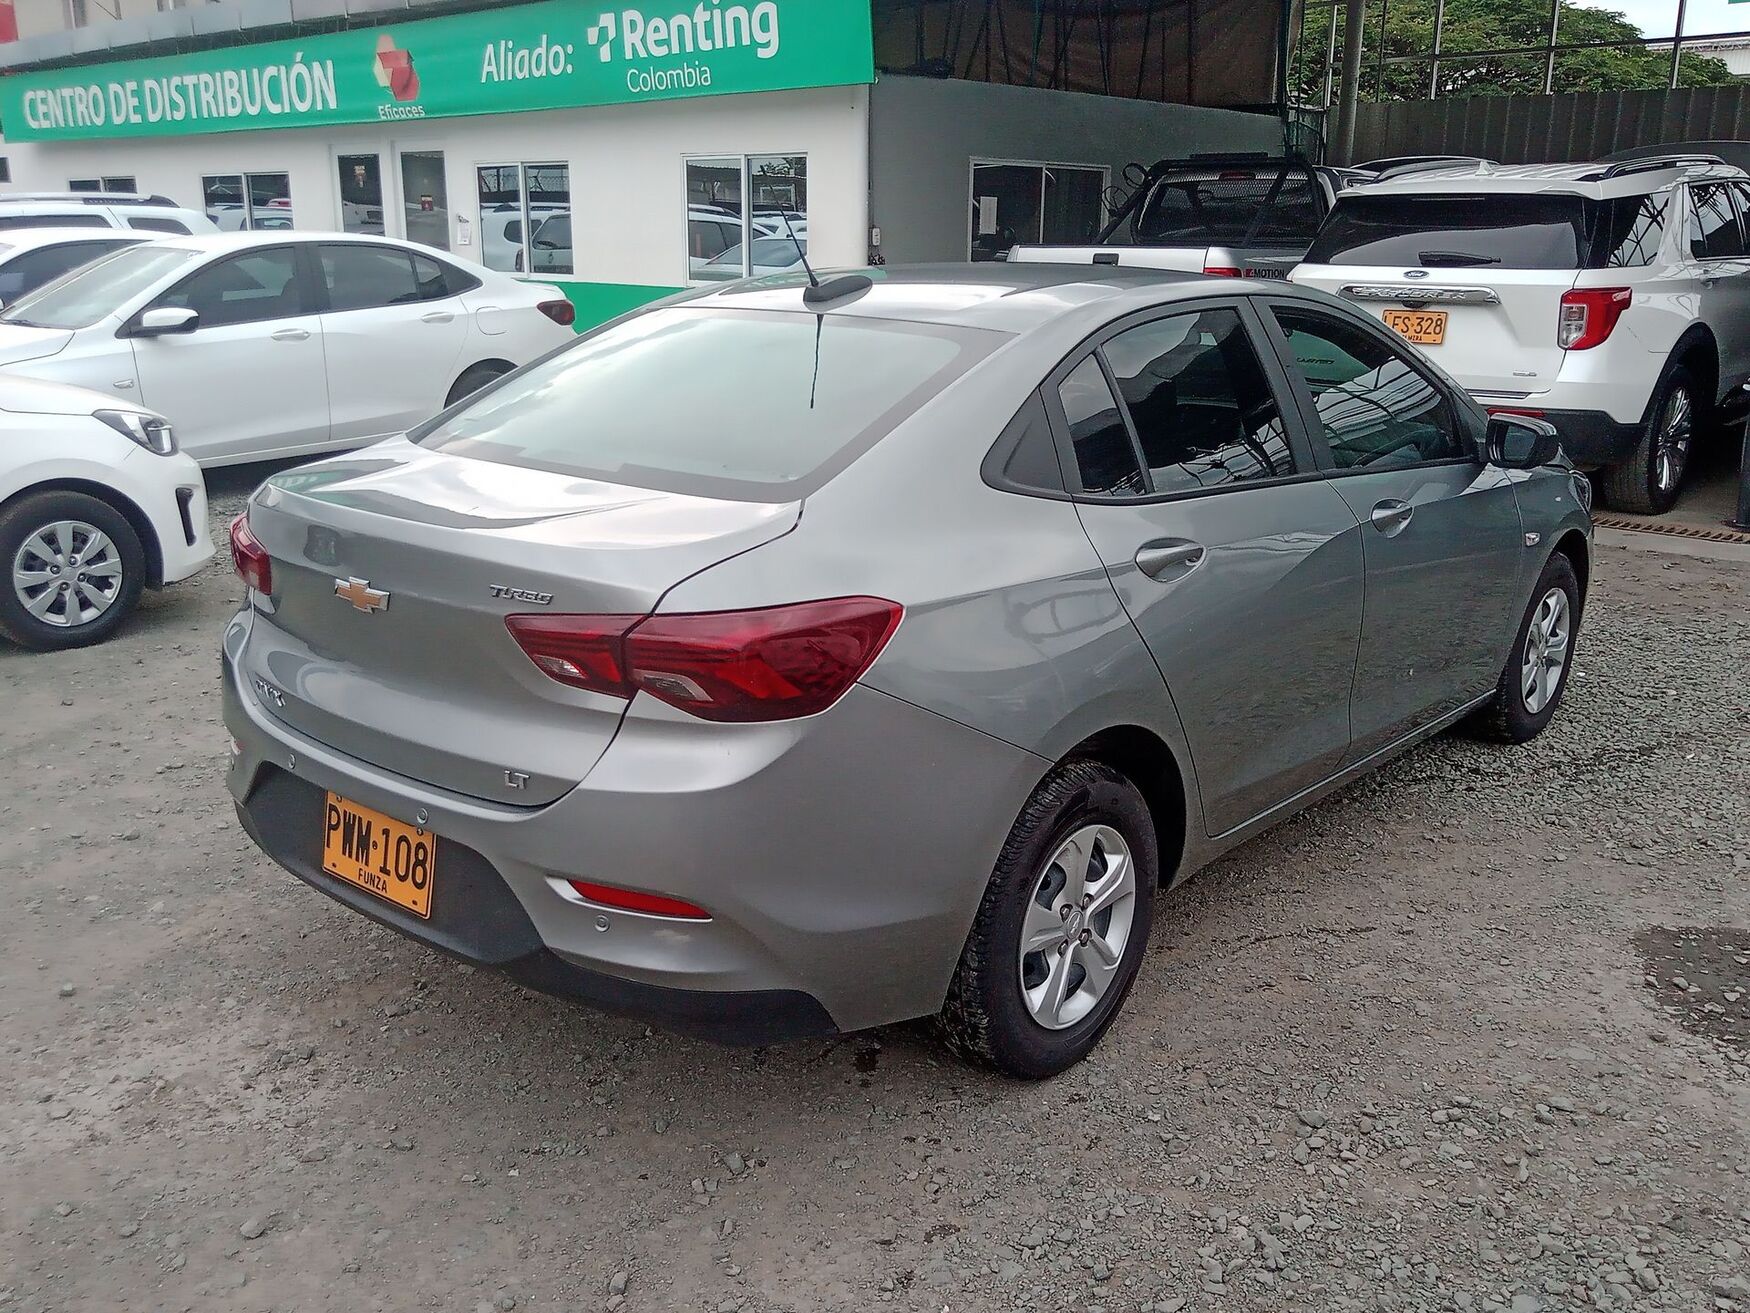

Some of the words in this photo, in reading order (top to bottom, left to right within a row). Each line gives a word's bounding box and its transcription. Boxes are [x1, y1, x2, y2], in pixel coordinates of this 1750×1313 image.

[624, 1, 780, 59] Renting
[481, 35, 575, 84] Aliado:
[23, 85, 106, 129] CENTRO
[106, 80, 142, 126] DE
[144, 52, 338, 123] DISTRIBUCIÓN
[626, 62, 712, 94] Colombia
[378, 104, 426, 120] Eficaces
[504, 770, 530, 789] LT
[358, 867, 388, 894] FUNZA
